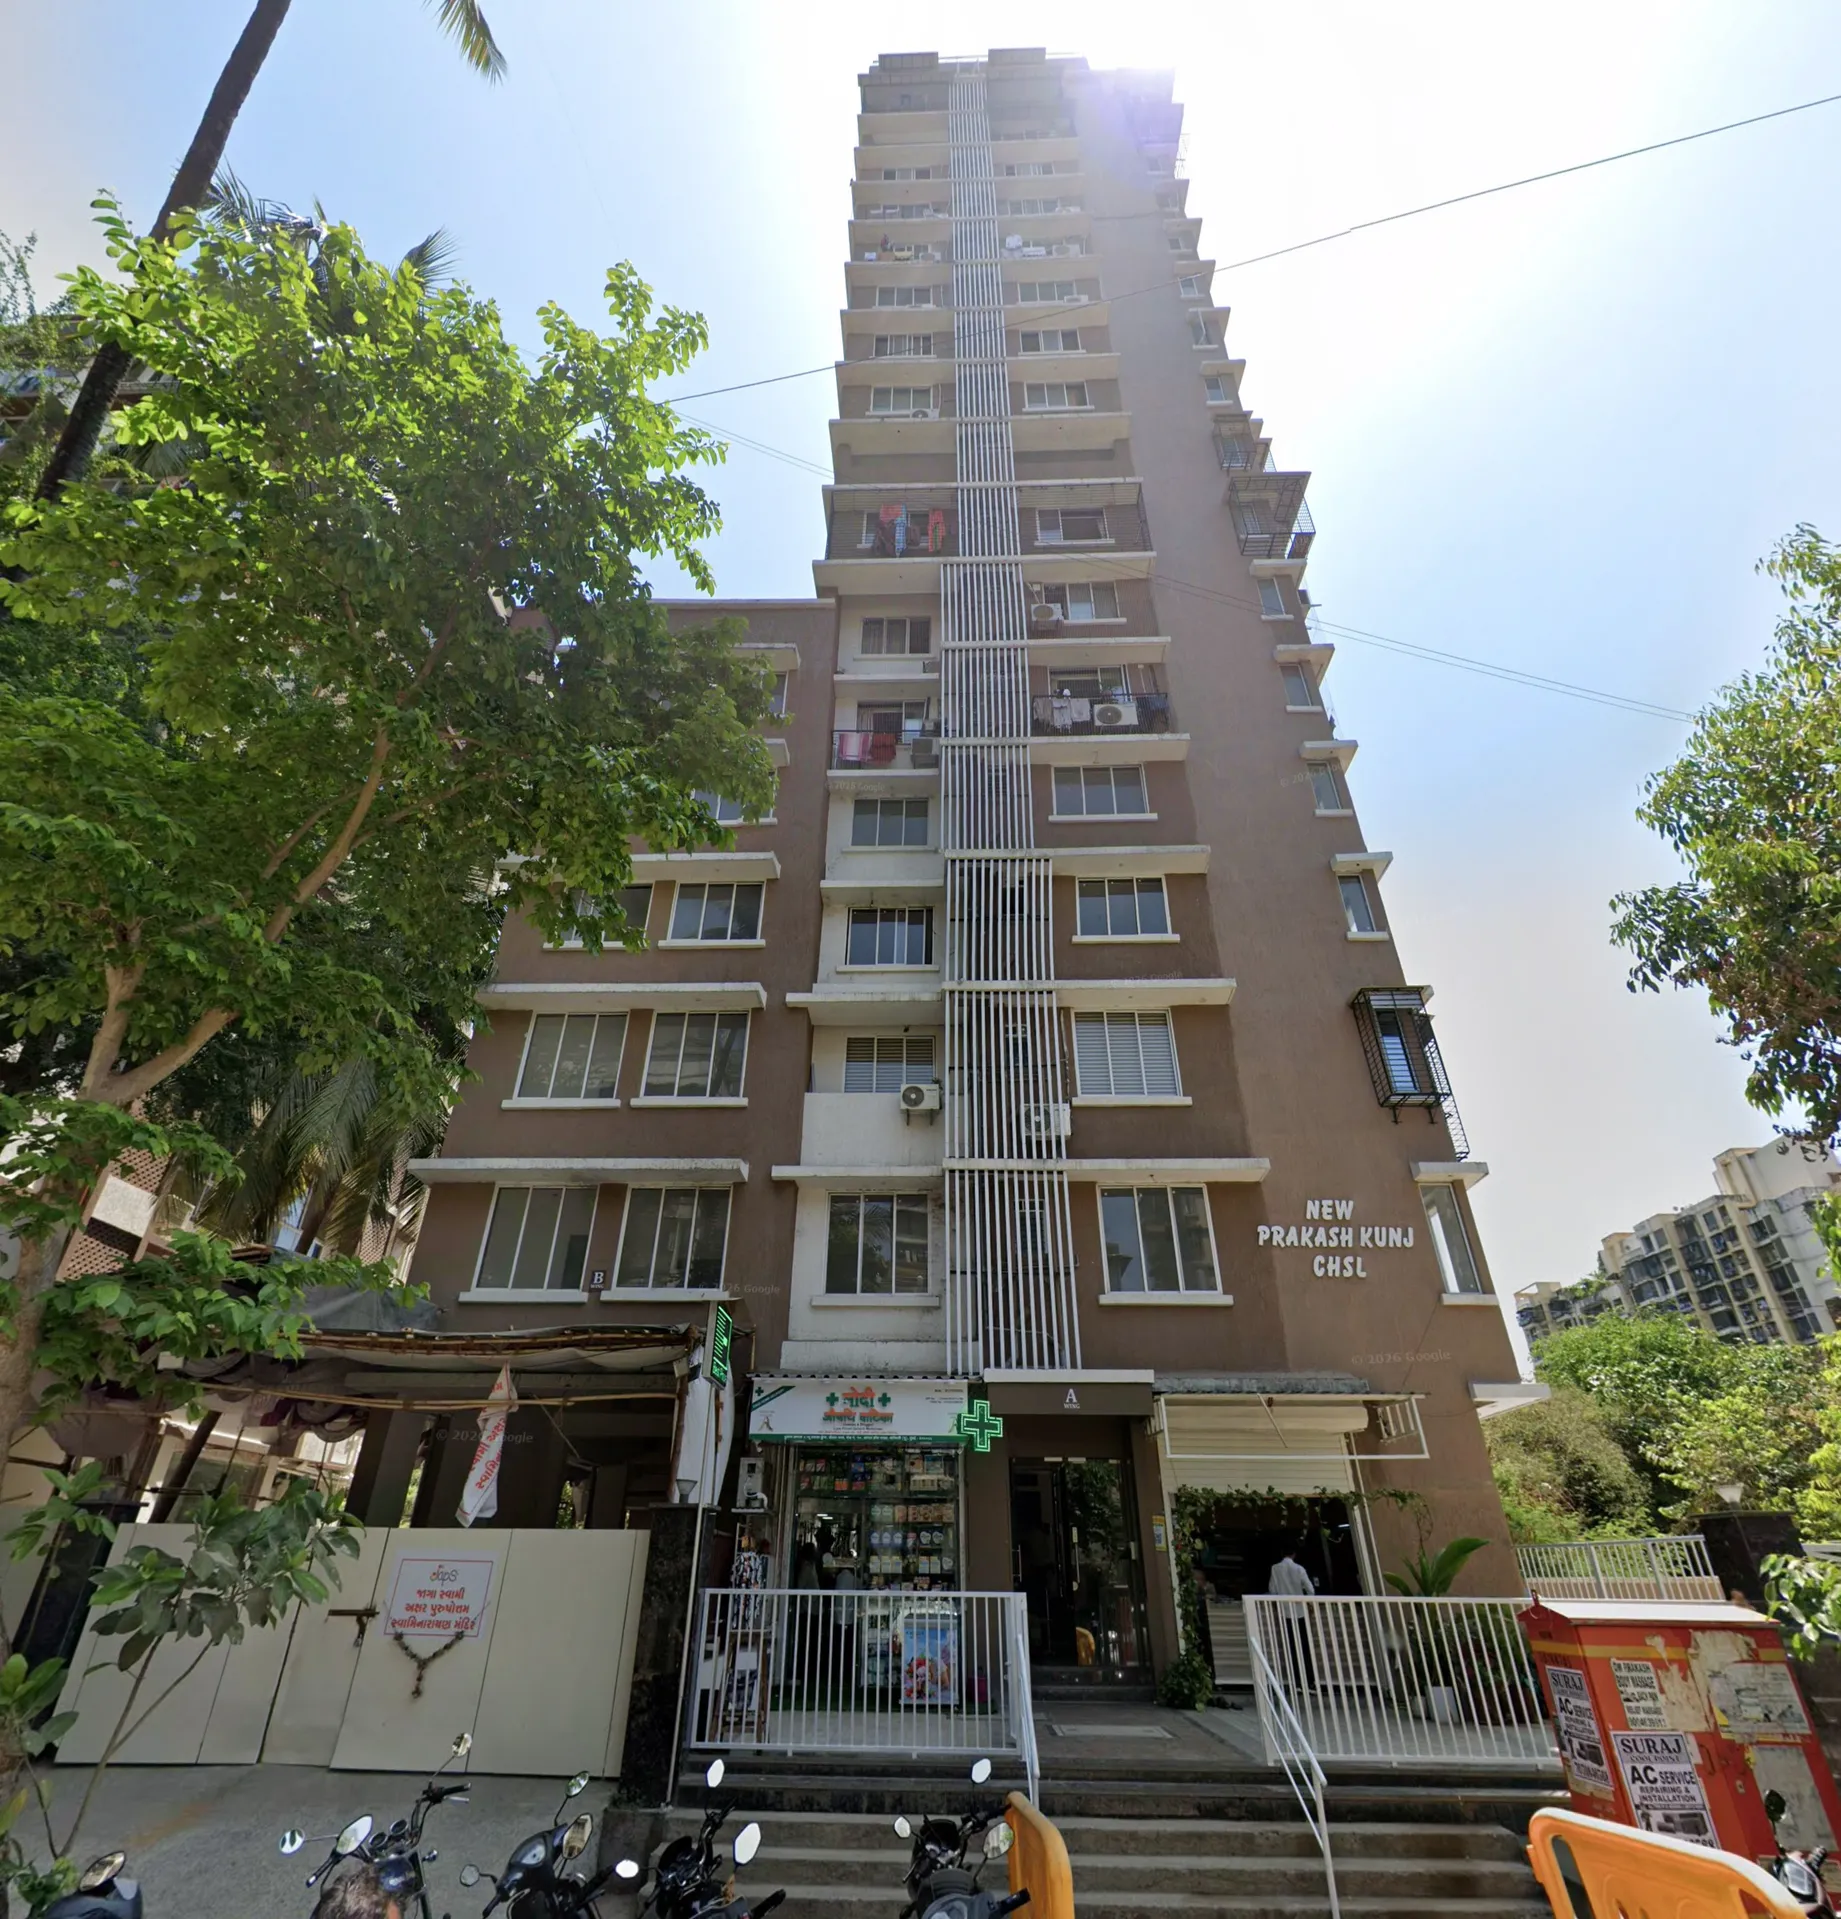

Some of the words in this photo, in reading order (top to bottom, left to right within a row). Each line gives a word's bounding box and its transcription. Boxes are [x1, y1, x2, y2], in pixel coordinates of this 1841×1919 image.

[1306, 1199, 1354, 1221] NEW
[1257, 1225, 1354, 1249] PRAKASH
[1360, 1226, 1414, 1249] KUNJ
[1313, 1255, 1367, 1278] CHSL
[593, 1271, 604, 1284] B
[1065, 1388, 1077, 1403] A
[1551, 1673, 1584, 1692] SURAJ
[1558, 1697, 1574, 1716] AC
[1620, 1737, 1682, 1754] SURAJ
[1631, 1765, 1658, 1785] AC
[1659, 1771, 1696, 1785] SERVICE
[1639, 1785, 1682, 1794] REPAIRING
[1639, 1794, 1697, 1802] INSTALLATION
